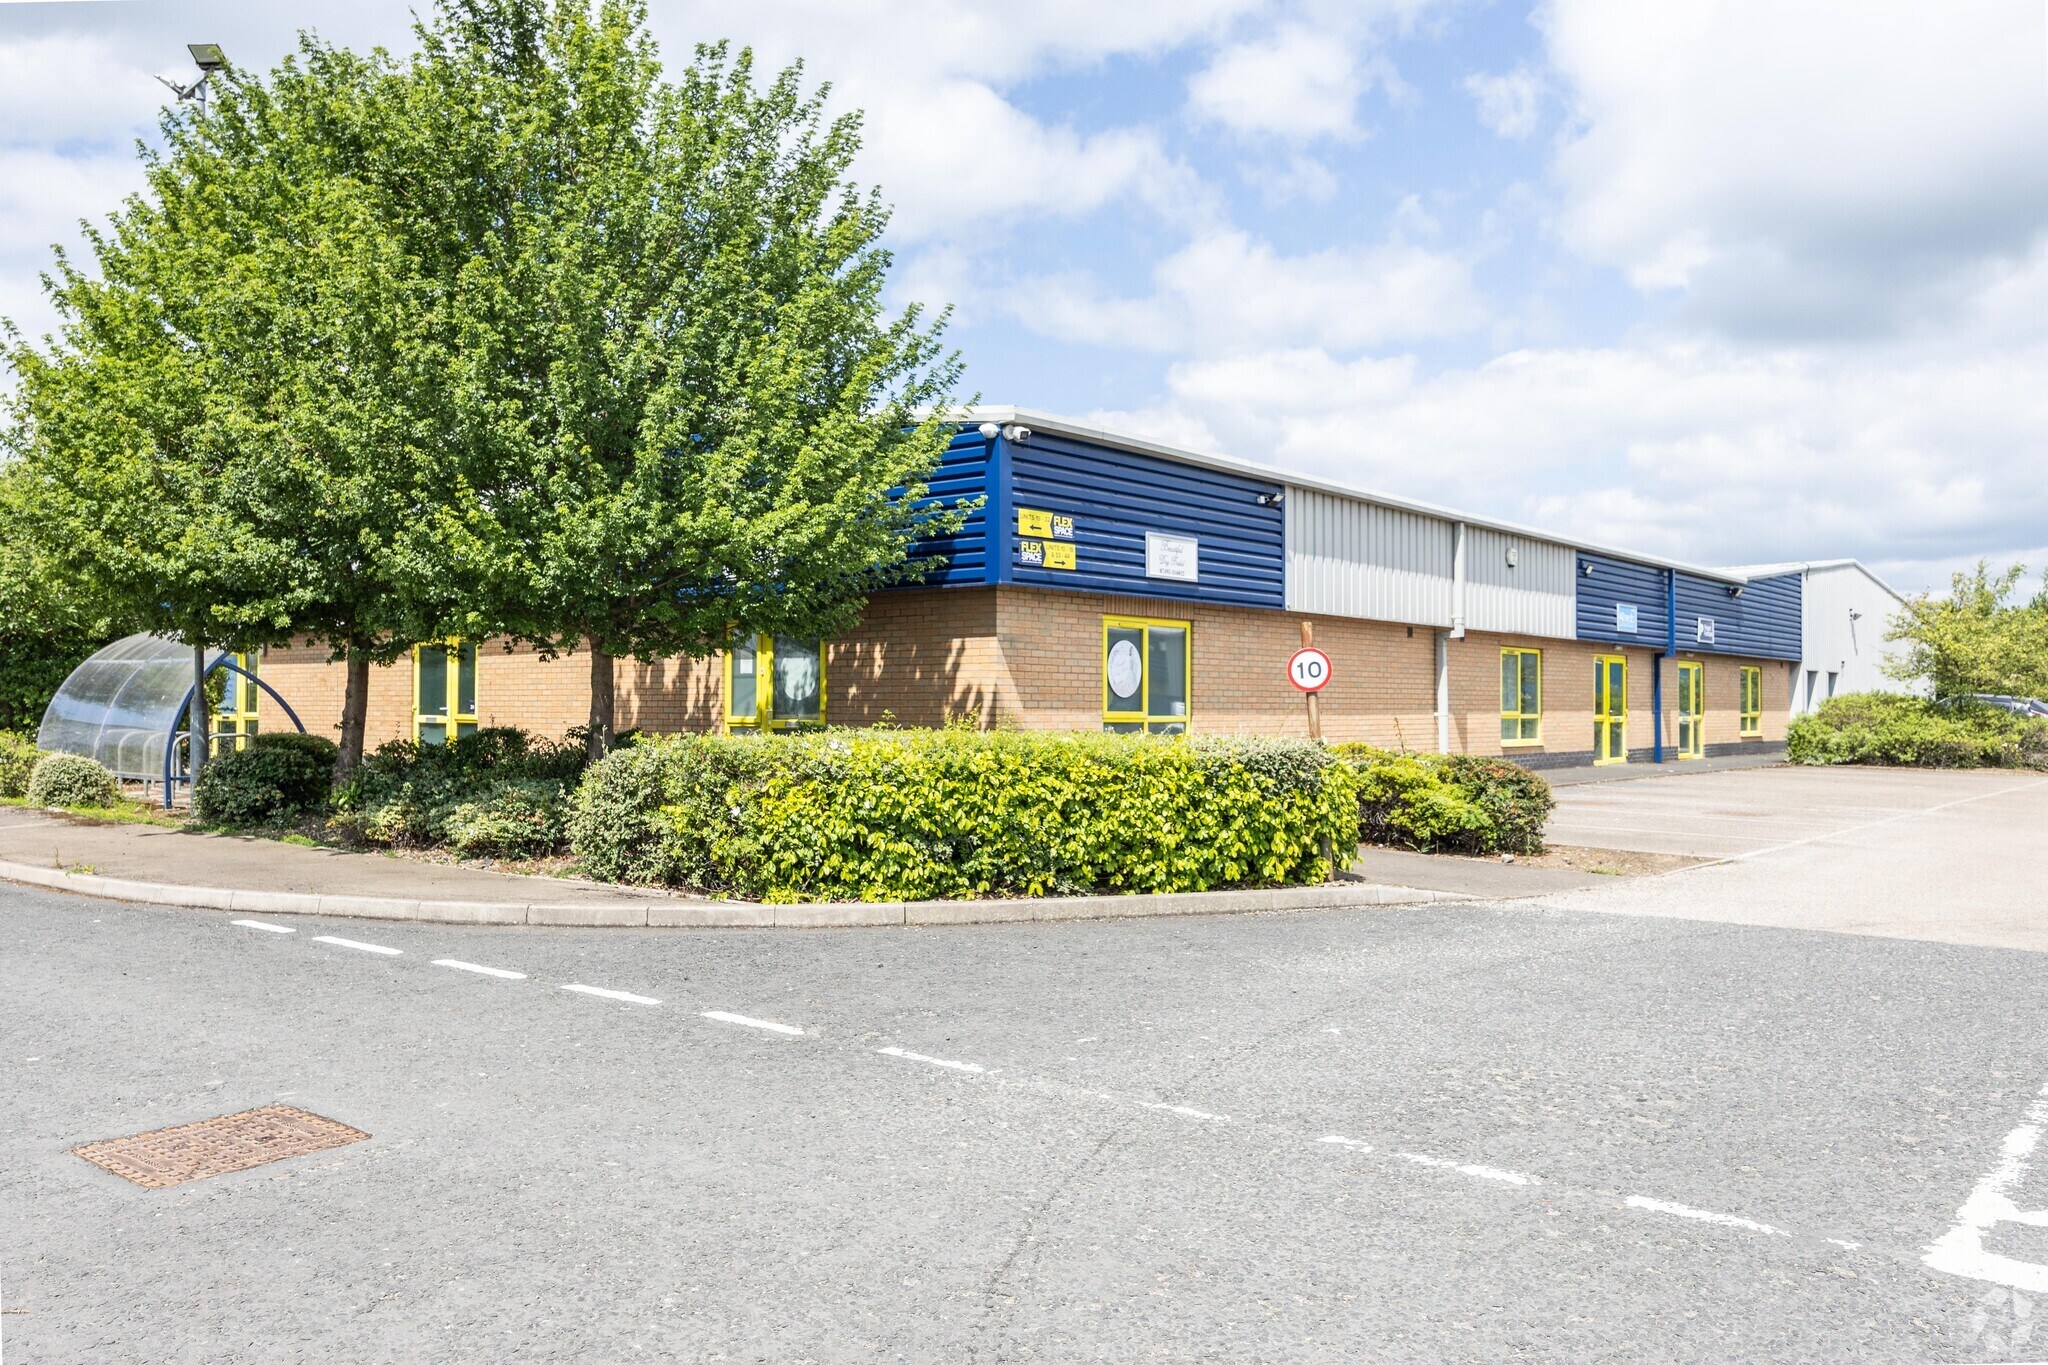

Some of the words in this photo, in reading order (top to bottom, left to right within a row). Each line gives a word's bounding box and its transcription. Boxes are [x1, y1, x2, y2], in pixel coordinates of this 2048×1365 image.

[1021, 513, 1035, 521] UNITS
[1053, 515, 1073, 528] FLEX
[1053, 525, 1074, 536] SPACE
[1021, 541, 1042, 553] FLEX
[1021, 551, 1042, 562] SPACE
[1297, 661, 1322, 679] 10
